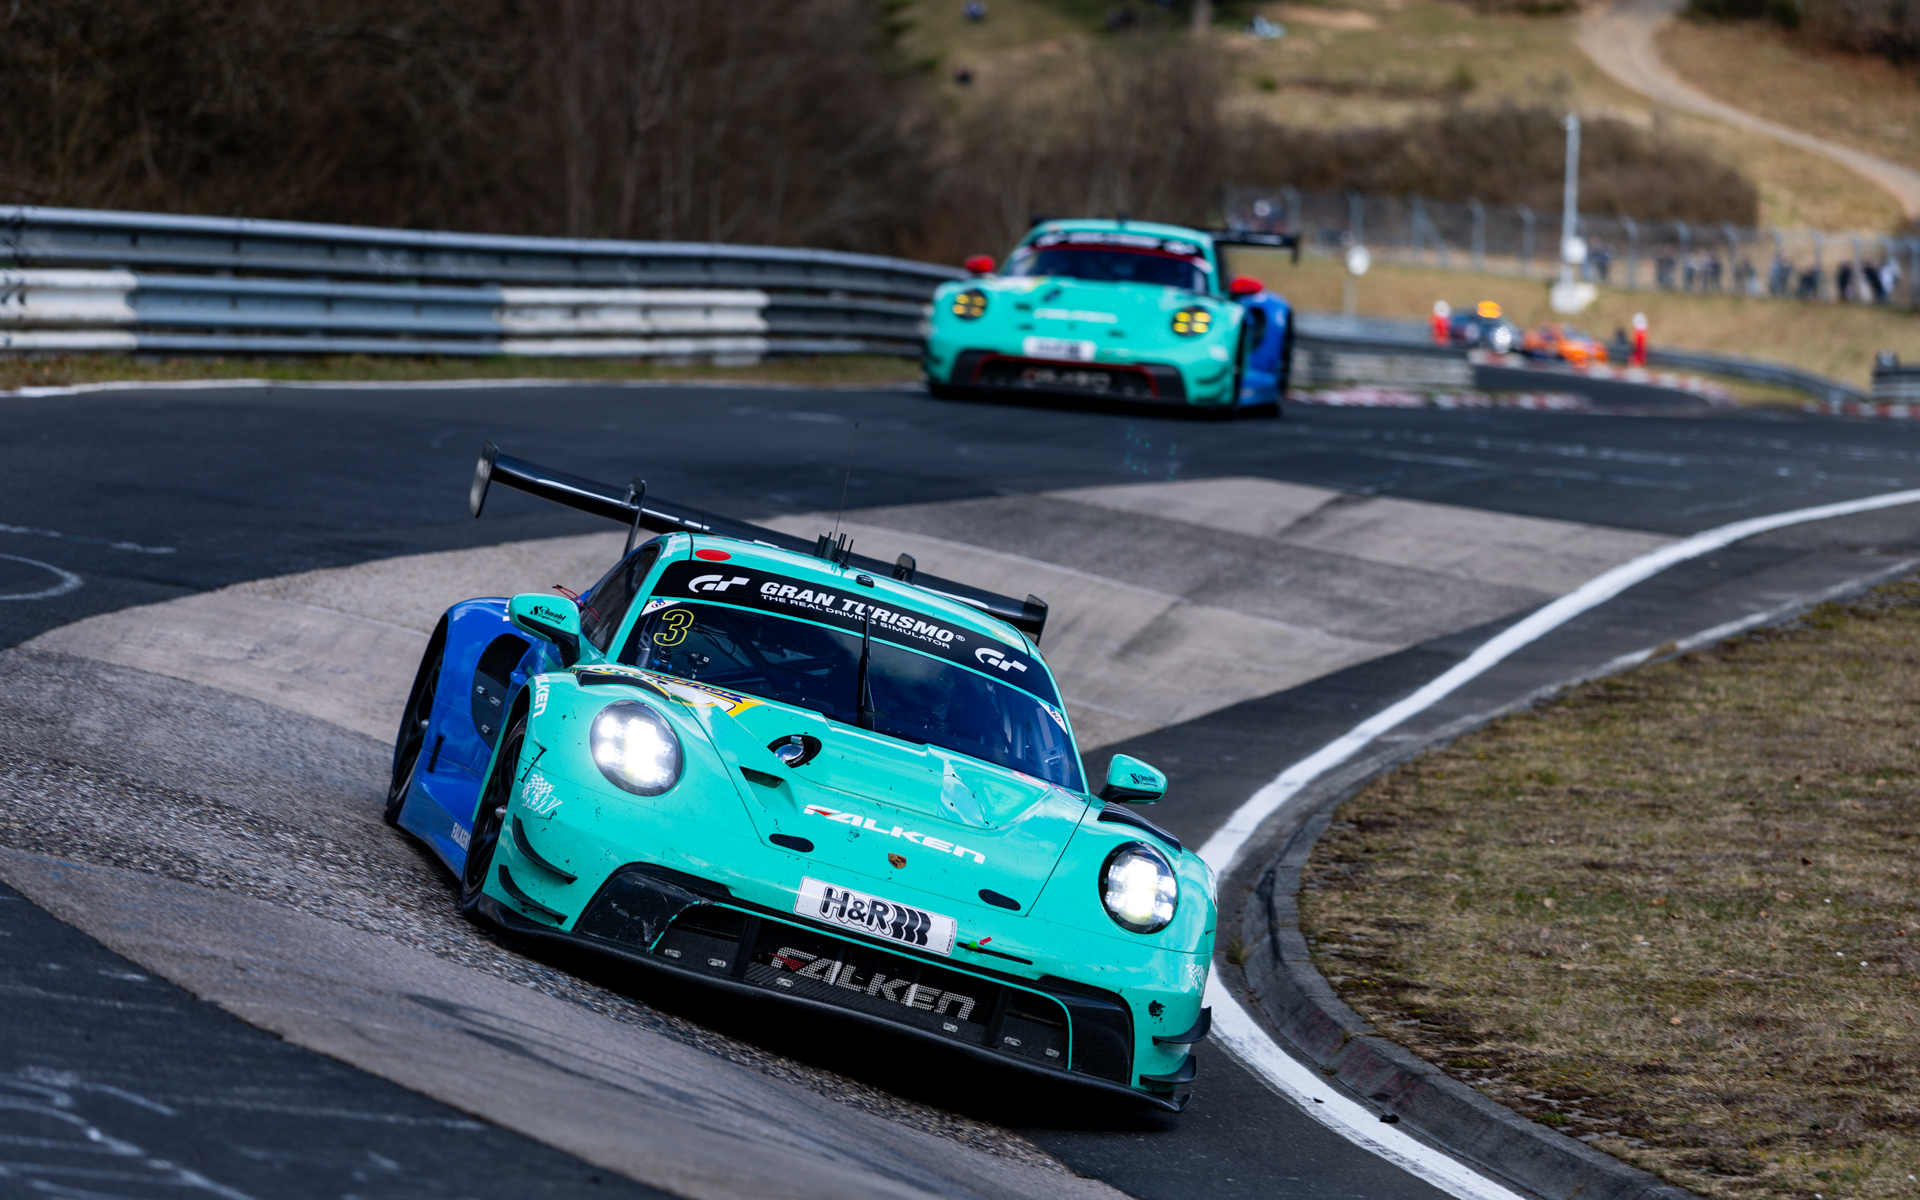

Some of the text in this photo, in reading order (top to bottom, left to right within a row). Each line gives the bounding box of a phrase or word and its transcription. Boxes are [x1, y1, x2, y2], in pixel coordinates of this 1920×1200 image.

[760, 581, 836, 607] GRAN
[653, 608, 695, 647] 3
[761, 594, 787, 604] THE
[790, 599, 823, 611] REAL
[880, 622, 951, 650] SIMULATOR
[800, 804, 986, 865] FALKEN
[820, 887, 891, 931] H&R
[768, 946, 976, 1021] FALKEN
